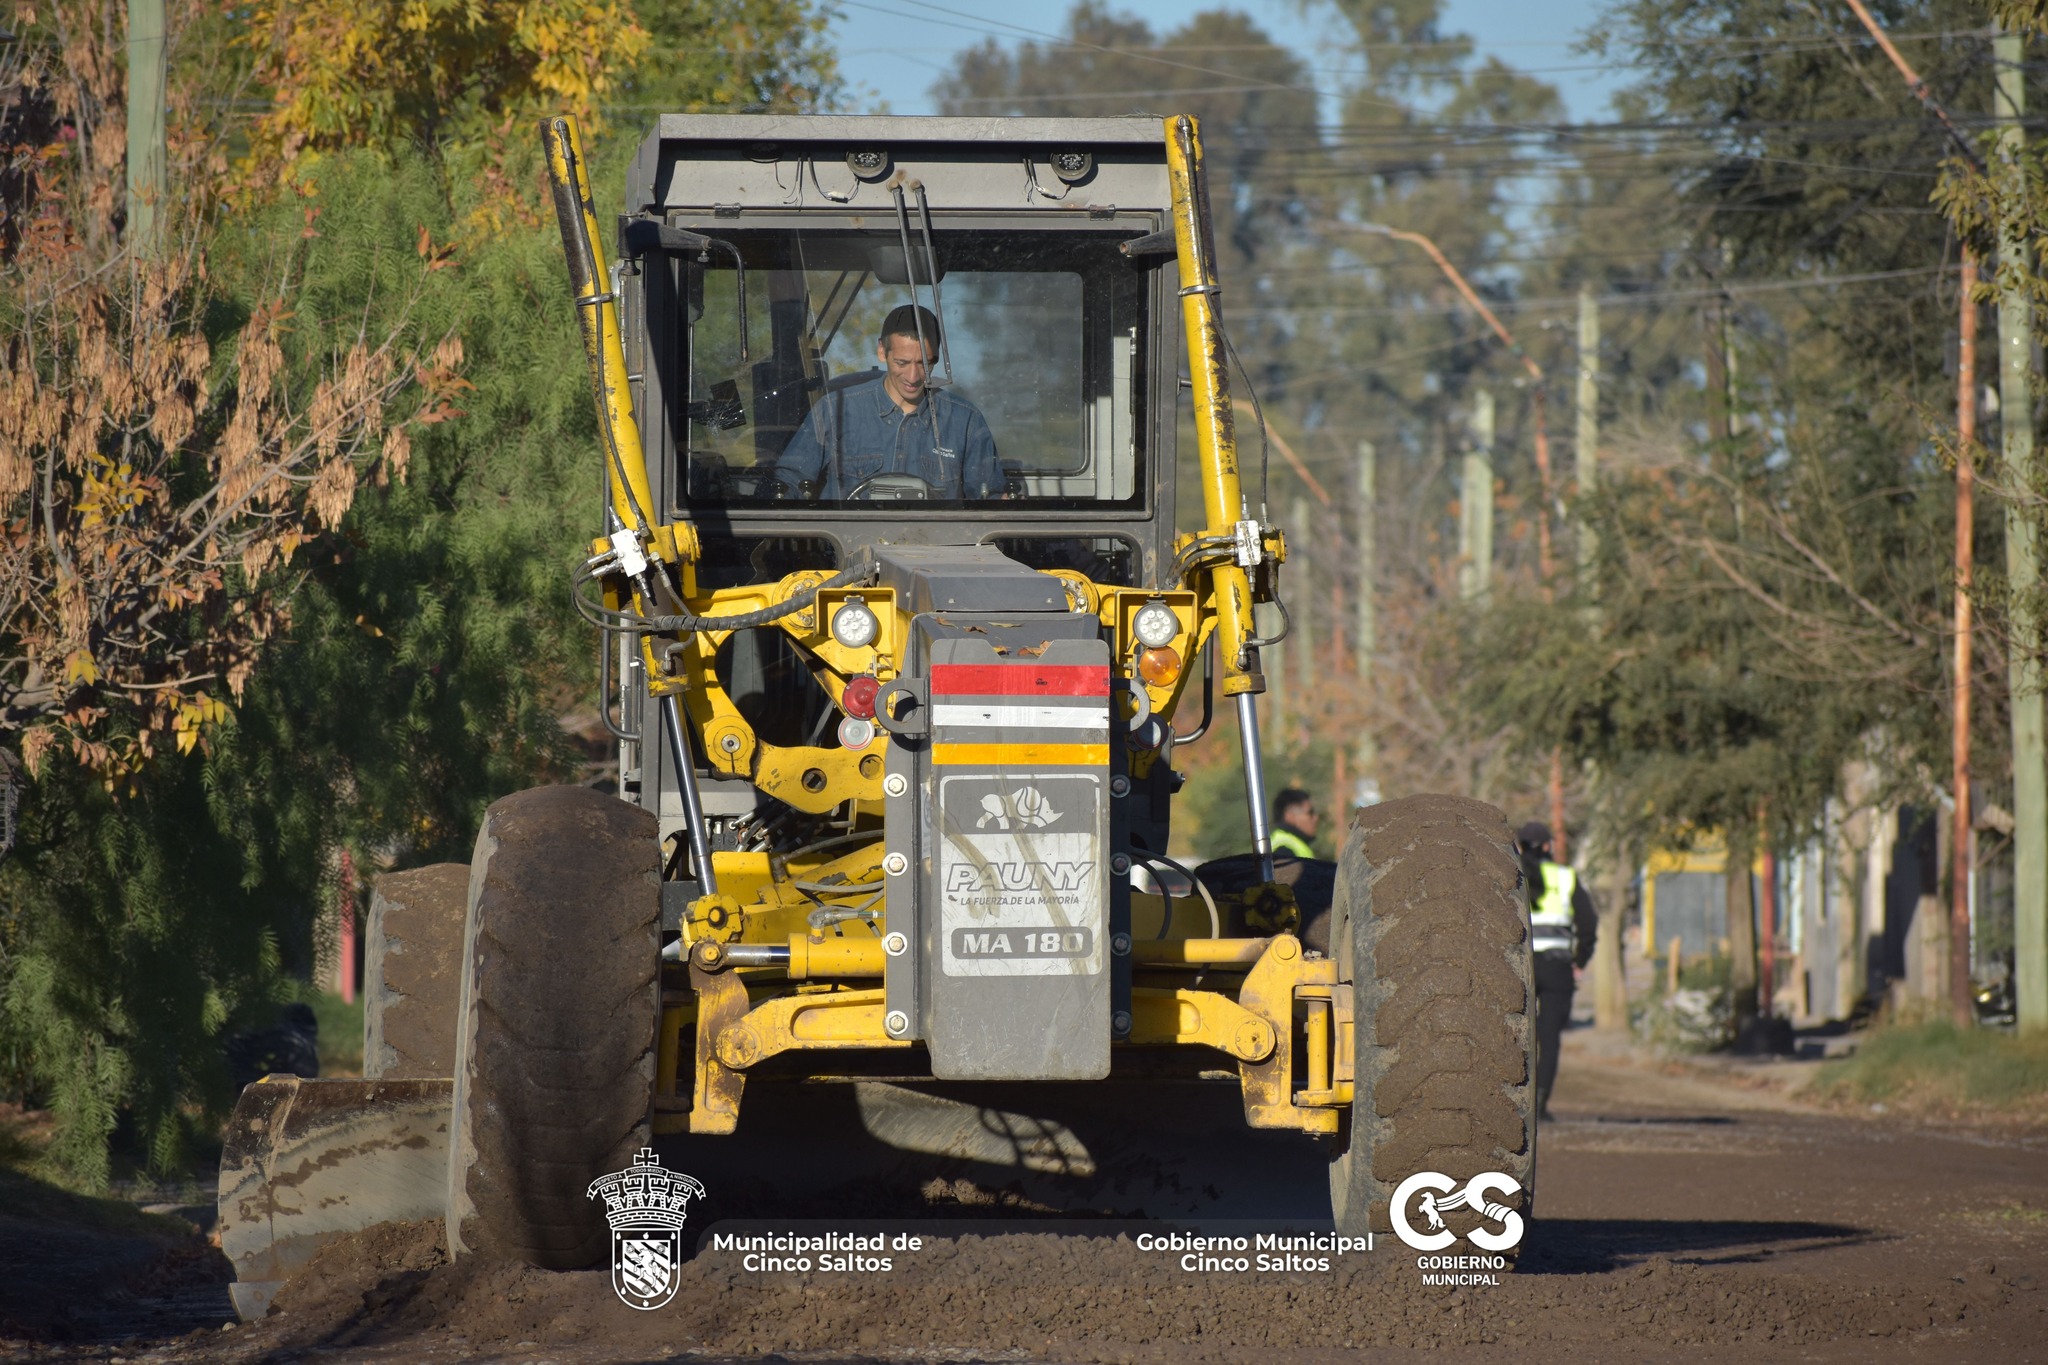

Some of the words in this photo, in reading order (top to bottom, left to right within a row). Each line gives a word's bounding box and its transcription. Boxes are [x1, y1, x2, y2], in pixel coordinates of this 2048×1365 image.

[946, 862, 1097, 892] PAUNY
[960, 898, 971, 906] LA
[973, 896, 1007, 906] FUERZA
[1010, 896, 1023, 905] DE
[1024, 896, 1037, 905] LA
[1037, 894, 1080, 905] MAYORÍA
[962, 933, 1013, 954] MA
[1024, 932, 1084, 953] 180
